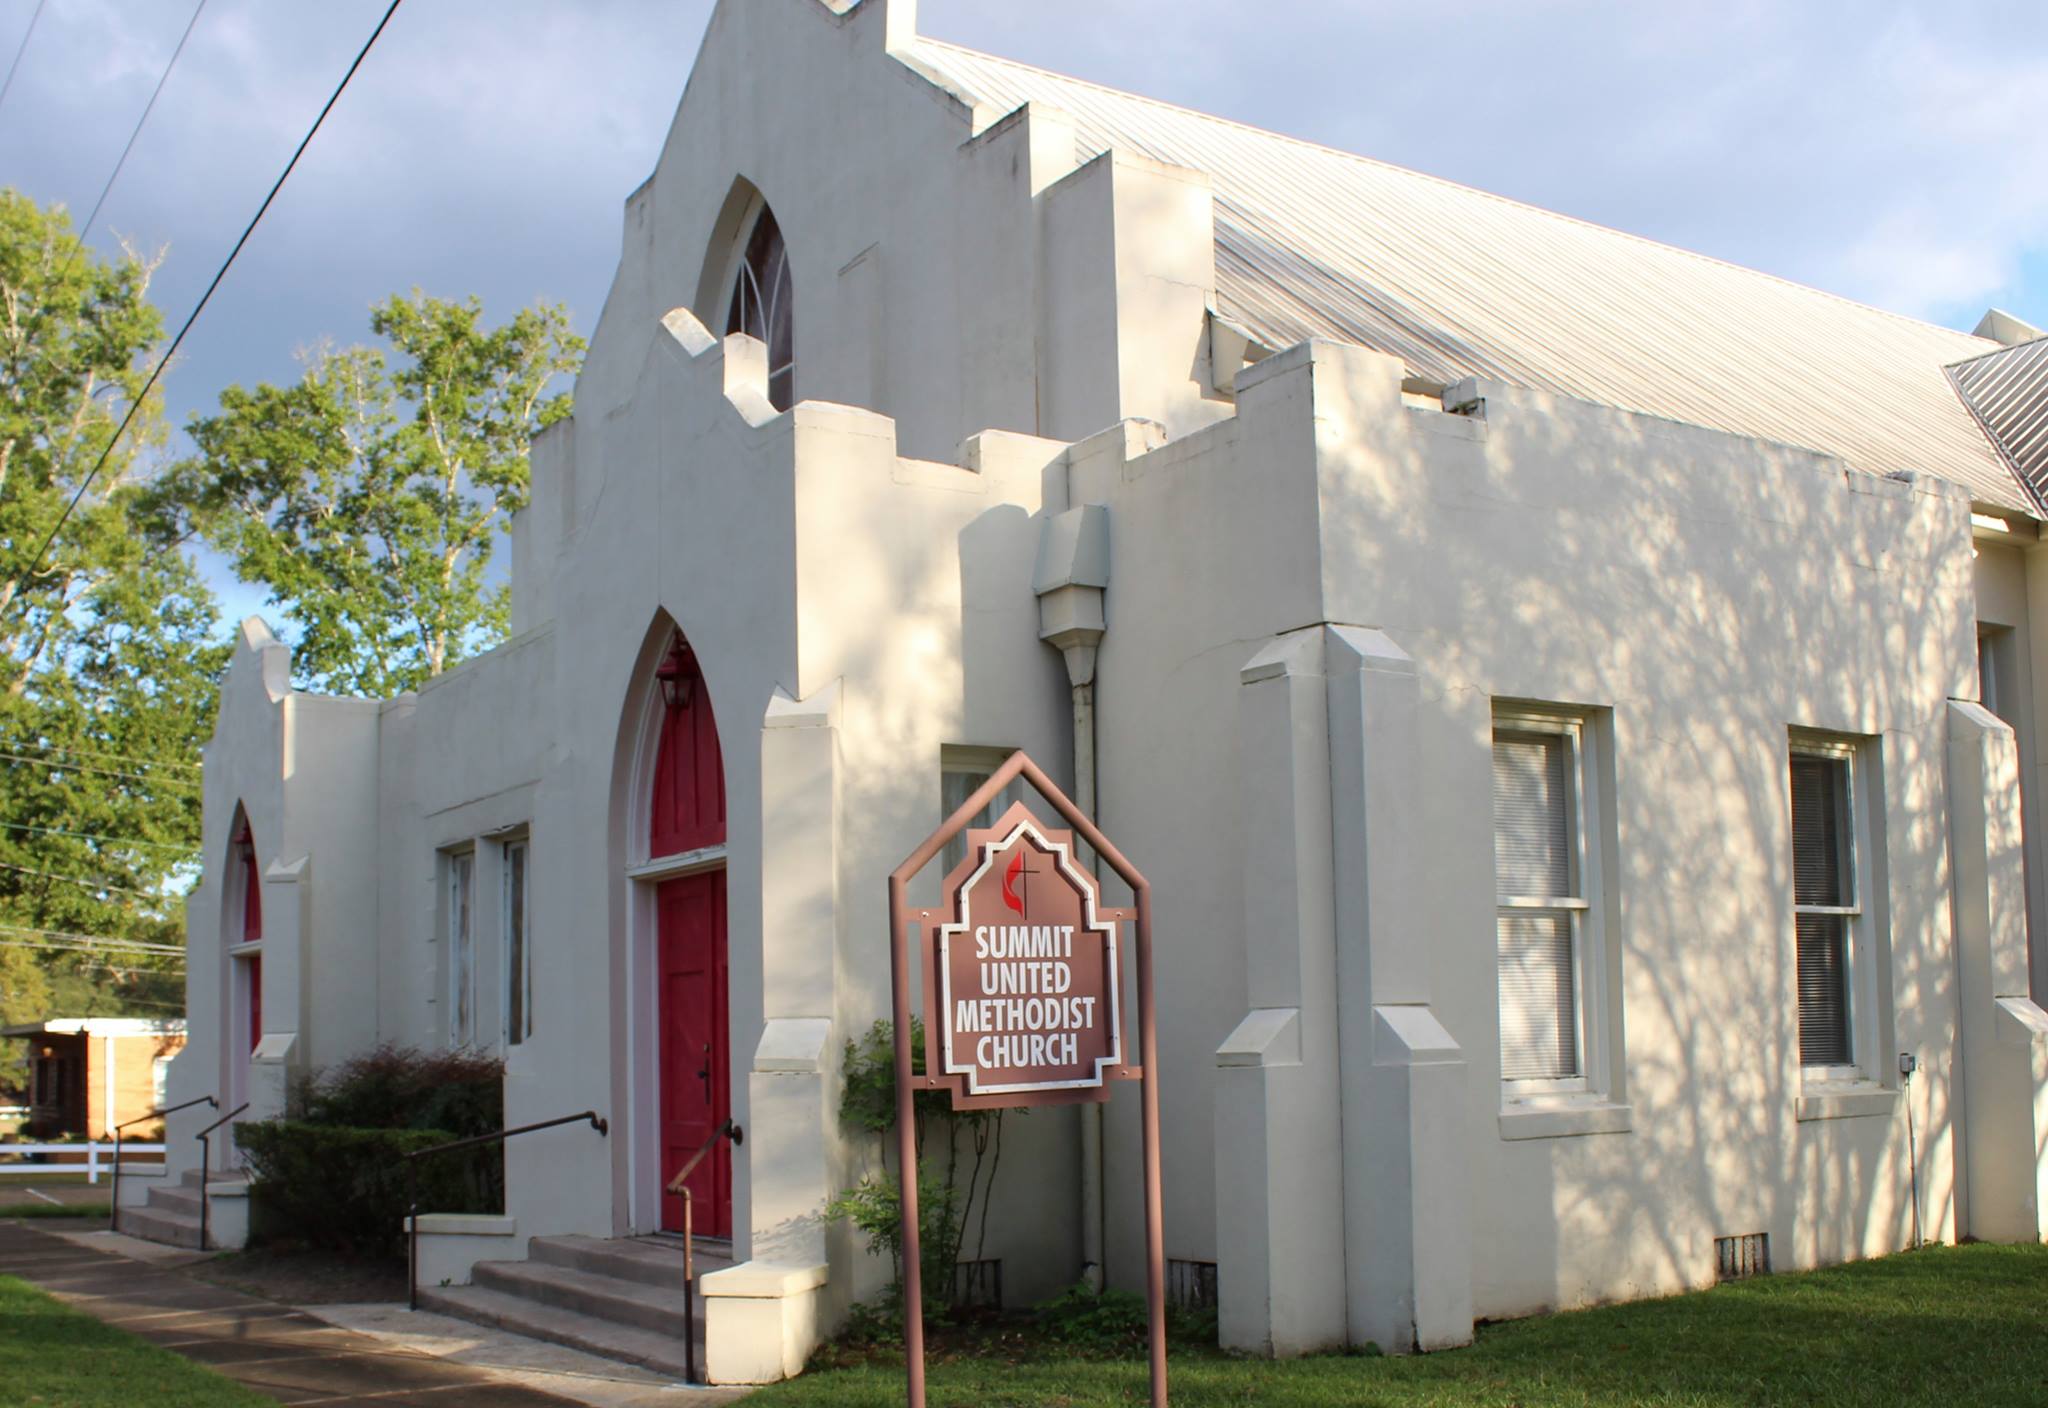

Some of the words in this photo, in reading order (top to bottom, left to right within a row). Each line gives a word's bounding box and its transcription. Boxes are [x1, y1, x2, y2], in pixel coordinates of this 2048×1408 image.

[975, 925, 1074, 959] SUMMIT
[980, 961, 1071, 995] UNITED
[956, 997, 1095, 1033] METHODIST
[976, 1033, 1078, 1069] CHURCH
